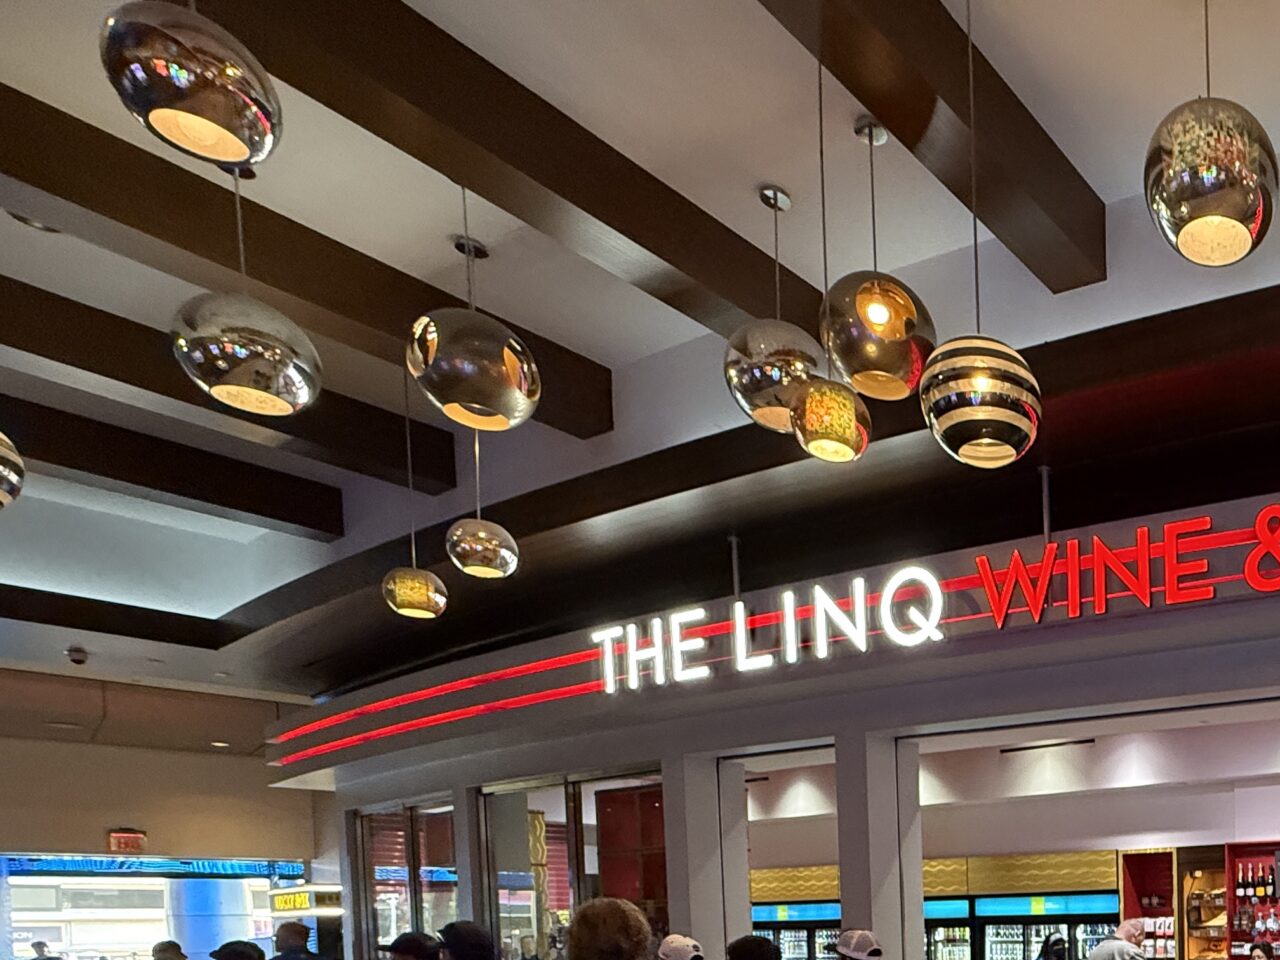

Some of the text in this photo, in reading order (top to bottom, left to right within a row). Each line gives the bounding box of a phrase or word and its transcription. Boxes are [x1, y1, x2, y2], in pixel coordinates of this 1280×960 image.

[591, 608, 710, 694] THE
[734, 566, 944, 671] LINQ
[975, 515, 1215, 629] WINE
